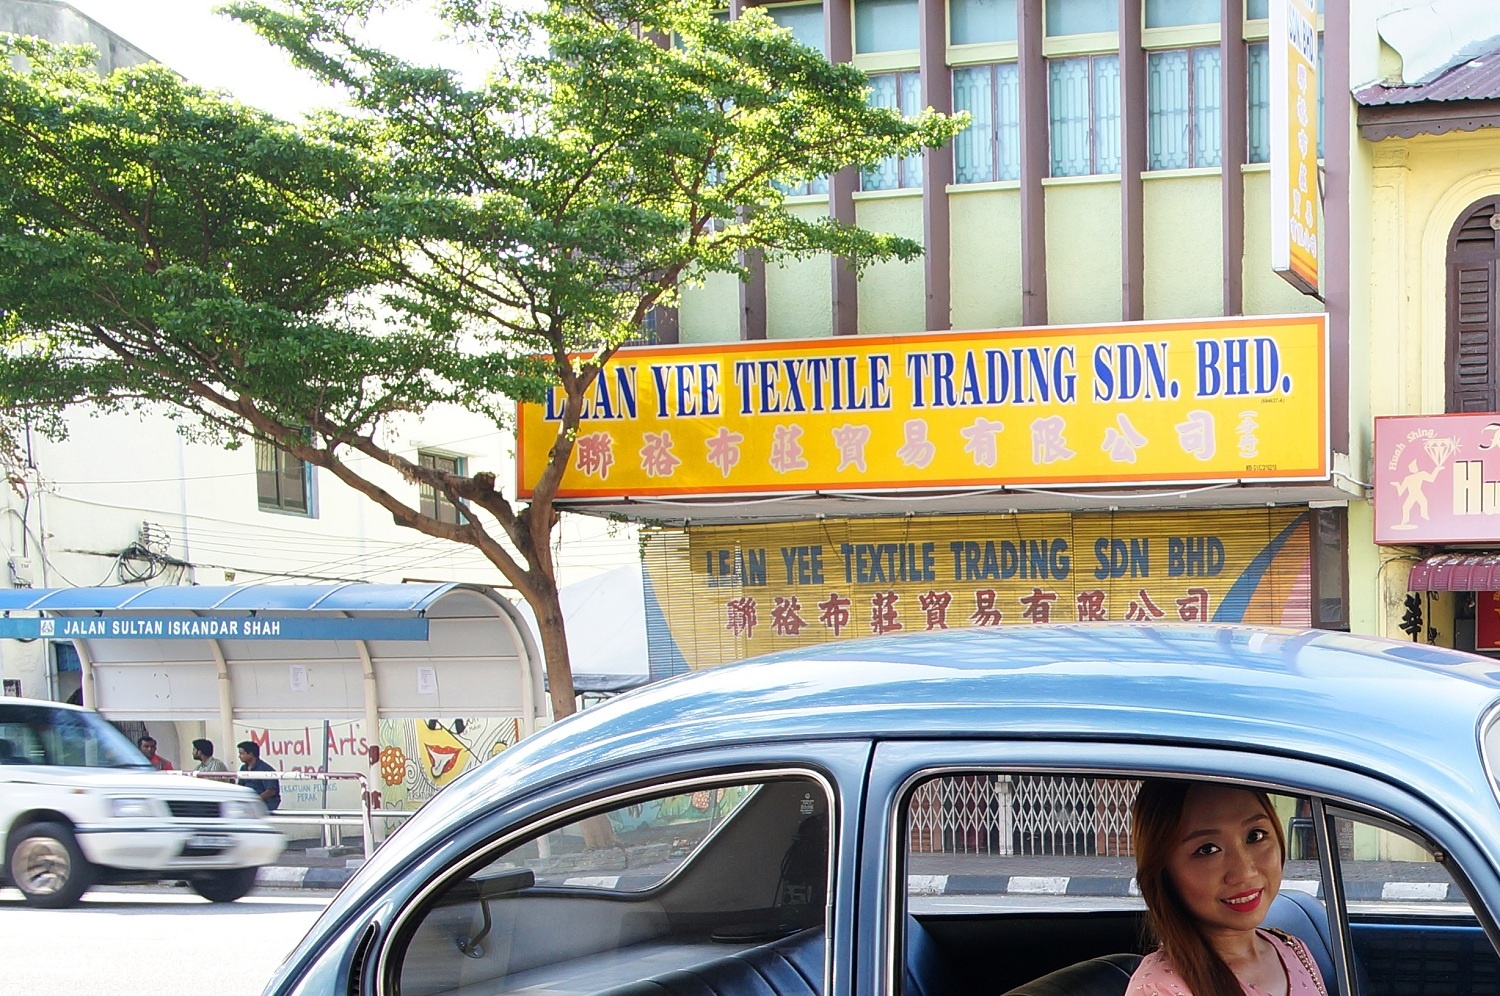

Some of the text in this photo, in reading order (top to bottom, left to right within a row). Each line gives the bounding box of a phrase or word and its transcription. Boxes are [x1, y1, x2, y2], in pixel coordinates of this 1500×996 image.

[545, 337, 1291, 420] LAN YEE TEXTILE TRADING SDN. BHD.
[1388, 428, 1437, 472] Huah Shing
[706, 536, 1226, 588] LEAN YEE TEXTILE TRADING SDN BHD
[63, 619, 281, 636] JALAN SULTAN ISKANDAR SHAH
[297, 792, 317, 802] PERAK
